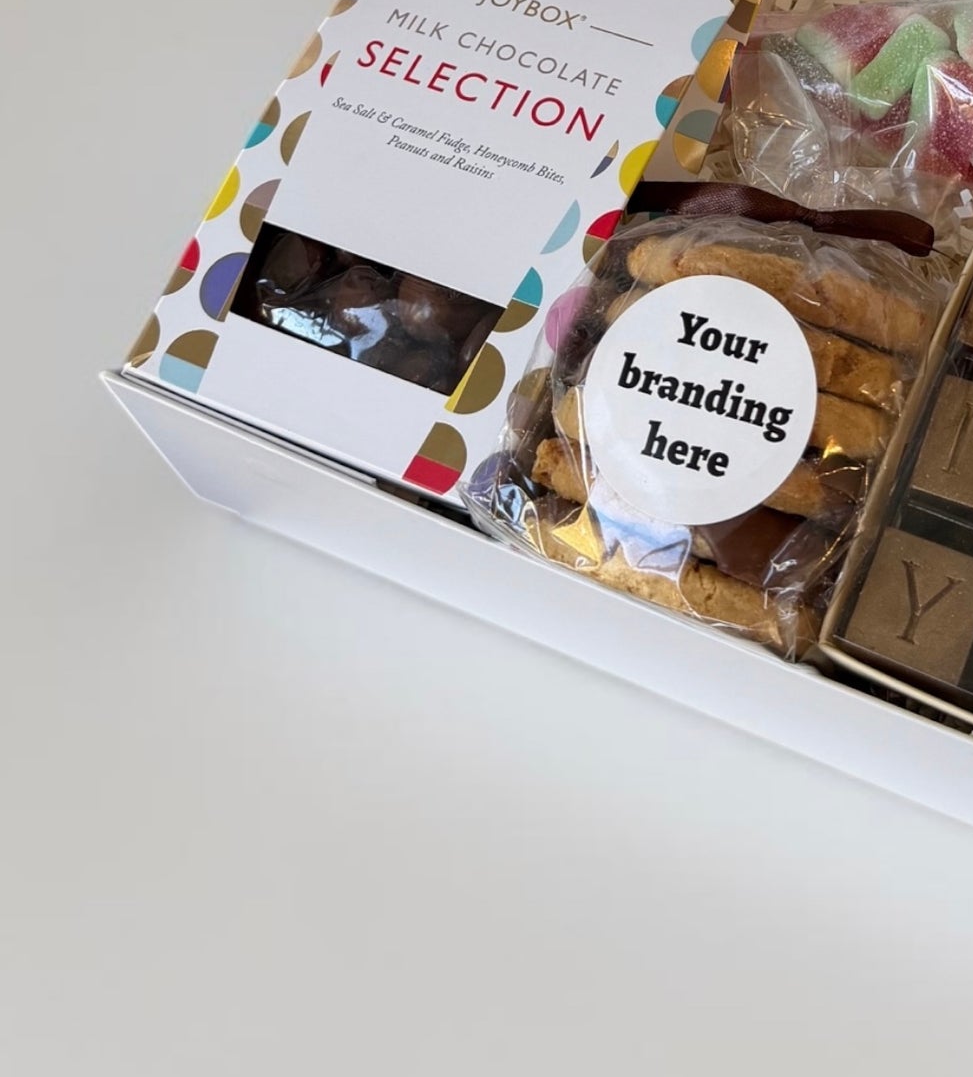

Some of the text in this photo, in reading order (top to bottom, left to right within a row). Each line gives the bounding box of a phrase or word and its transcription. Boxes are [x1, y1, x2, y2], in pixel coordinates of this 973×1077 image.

[357, 40, 605, 142] SELECTION
[386, 8, 622, 97] MILK CHOCOLATE
[332, 96, 565, 185] Sea Salt & Caramel Fudge, Honeycomb Bites,
[386, 134, 495, 180] Peanuts and Raisins
[677, 311, 768, 364] Your
[617, 351, 794, 443] branding
[641, 419, 729, 477] here
